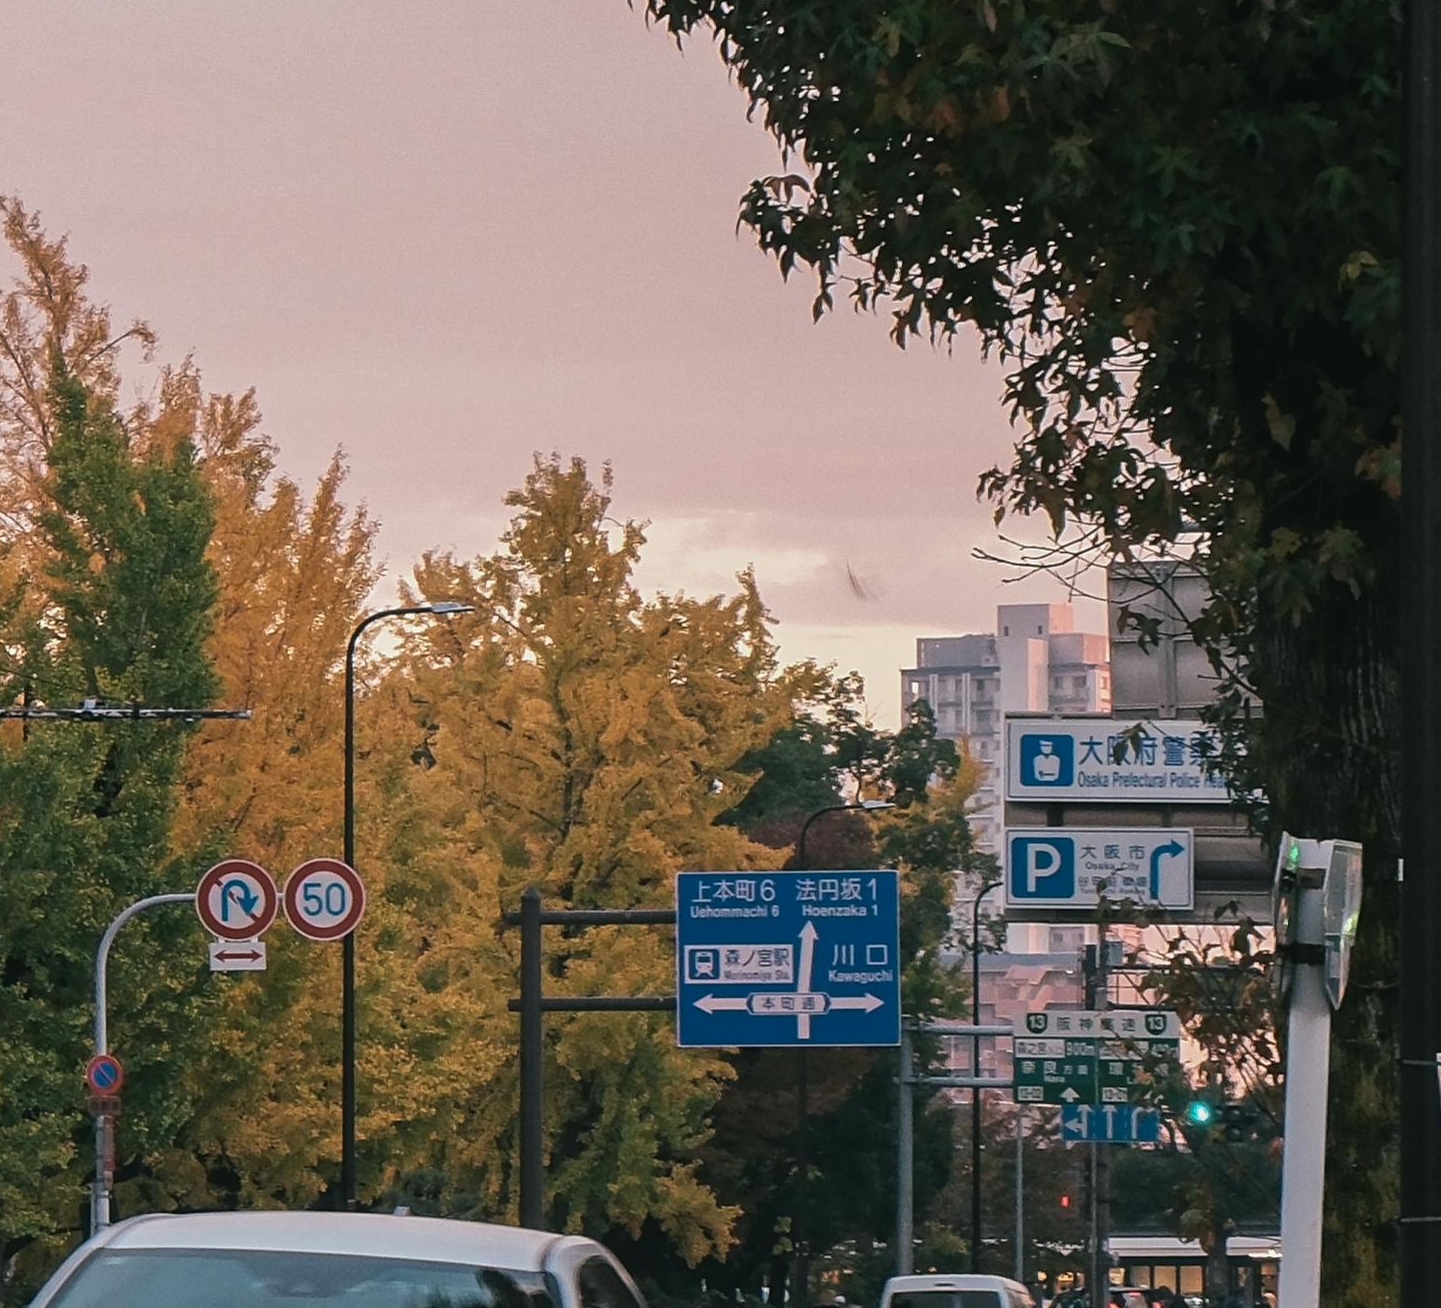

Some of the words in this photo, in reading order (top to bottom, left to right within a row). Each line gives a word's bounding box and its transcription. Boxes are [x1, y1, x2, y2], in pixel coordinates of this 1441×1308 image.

[1078, 772, 1110, 788] Osaka
[1112, 771, 1167, 788] Prefectural
[1170, 771, 1200, 788] Police
[1079, 844, 1145, 860] 大阪市
[1027, 843, 1062, 893] P
[302, 882, 347, 917] 50
[690, 905, 768, 918] Uehommachi
[770, 905, 780, 917] 6
[802, 904, 867, 917] Hoenzaka
[870, 904, 878, 916] 1
[724, 948, 790, 967] 森ノ宮駅
[828, 969, 893, 984] Kawaguchi
[1029, 1015, 1046, 1030] 13
[1147, 1015, 1165, 1030] 13
